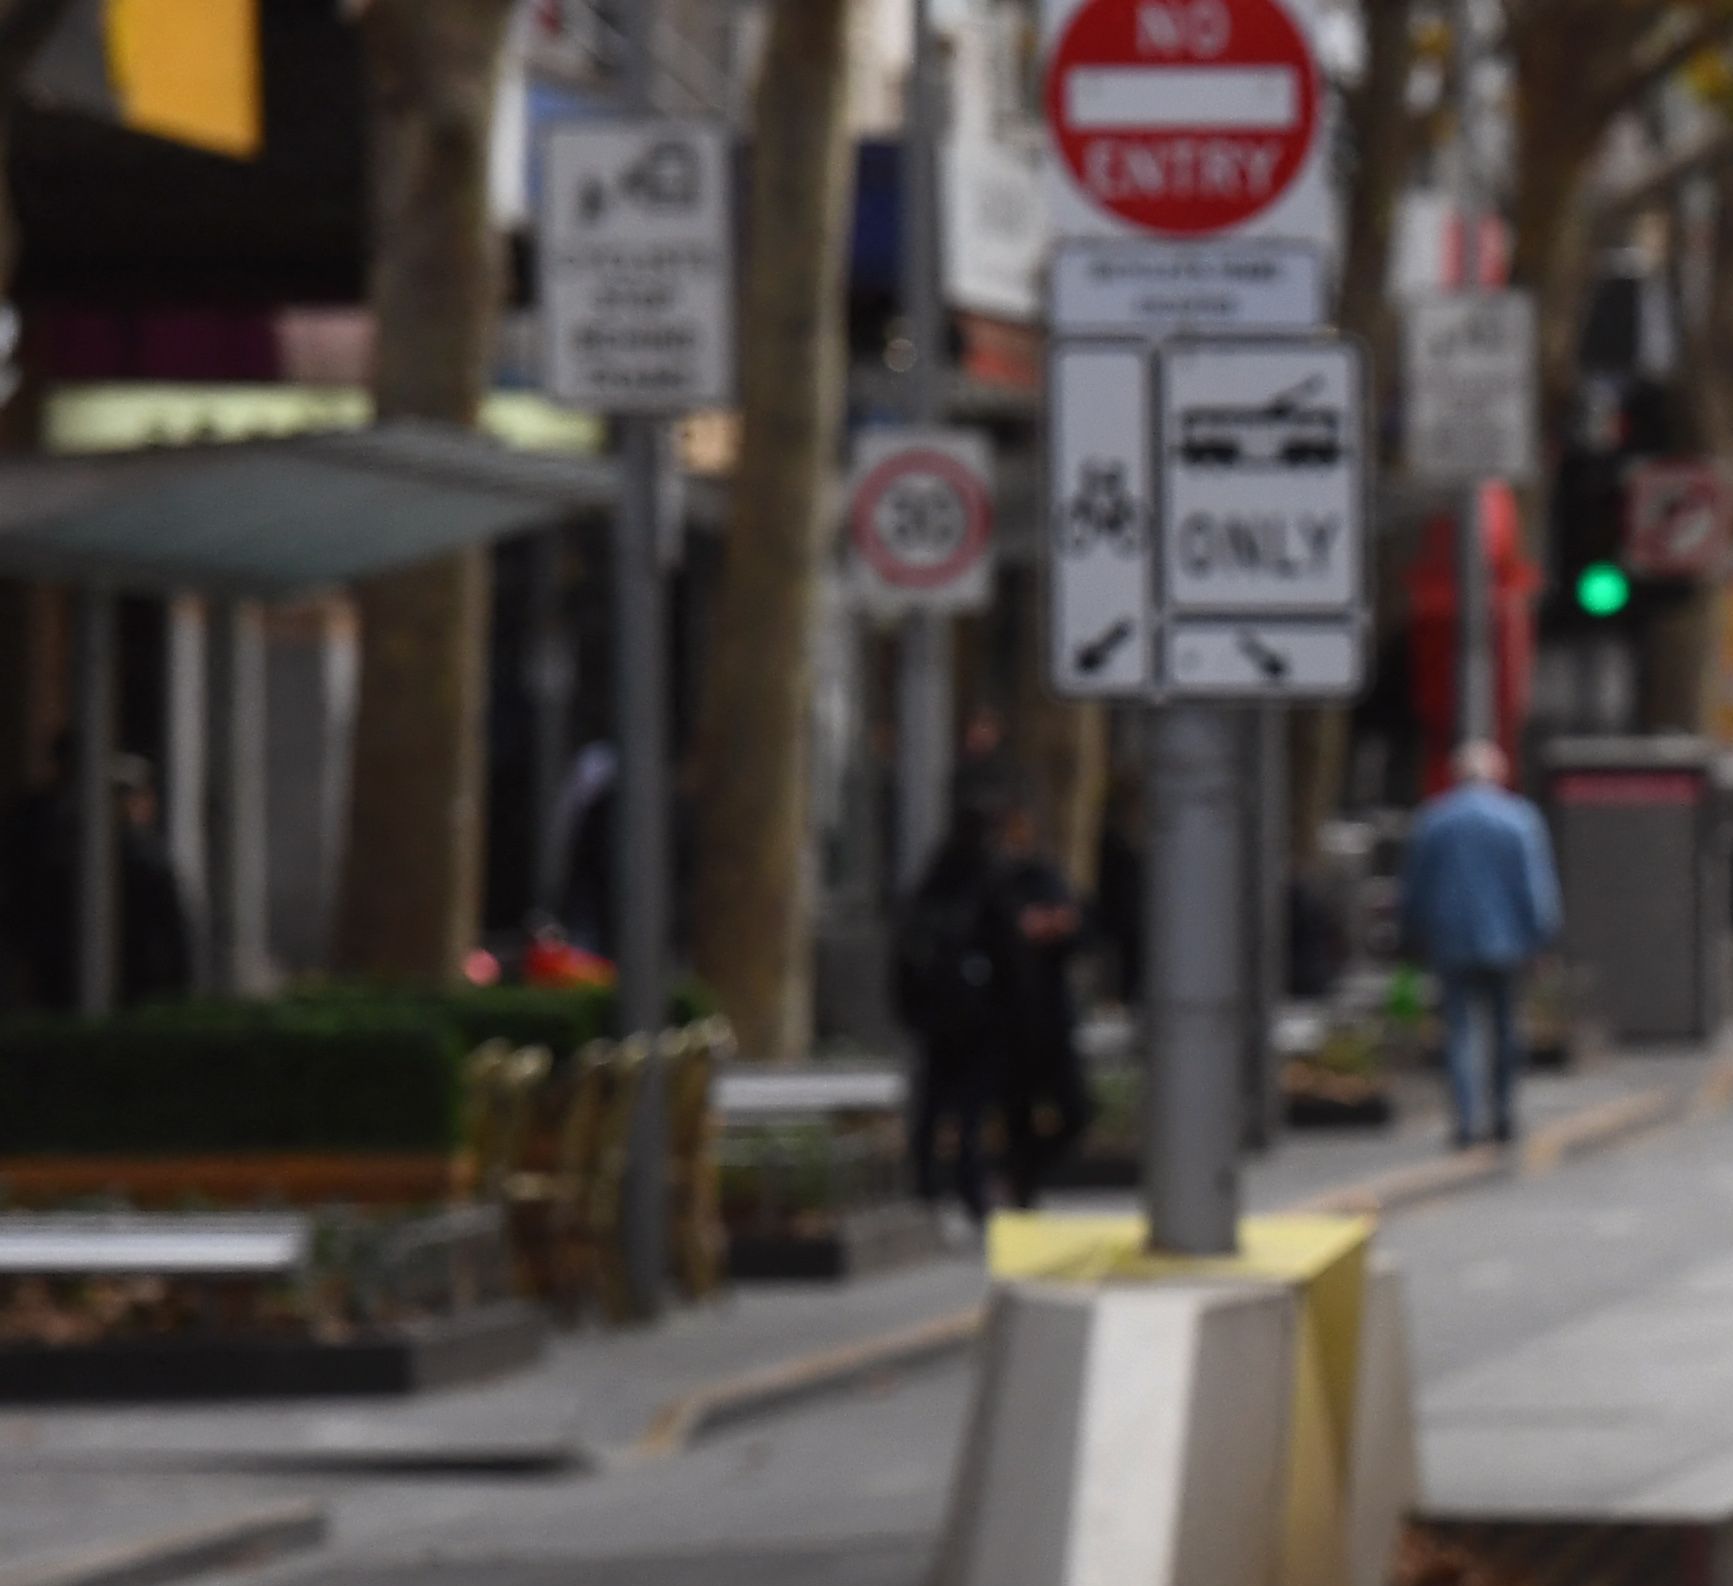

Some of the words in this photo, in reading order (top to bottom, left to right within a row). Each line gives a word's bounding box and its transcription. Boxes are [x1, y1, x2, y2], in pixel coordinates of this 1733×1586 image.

[1135, 0, 1232, 55] NO
[1084, 138, 1284, 200] ENTRY
[1178, 509, 1341, 580] ONLY
